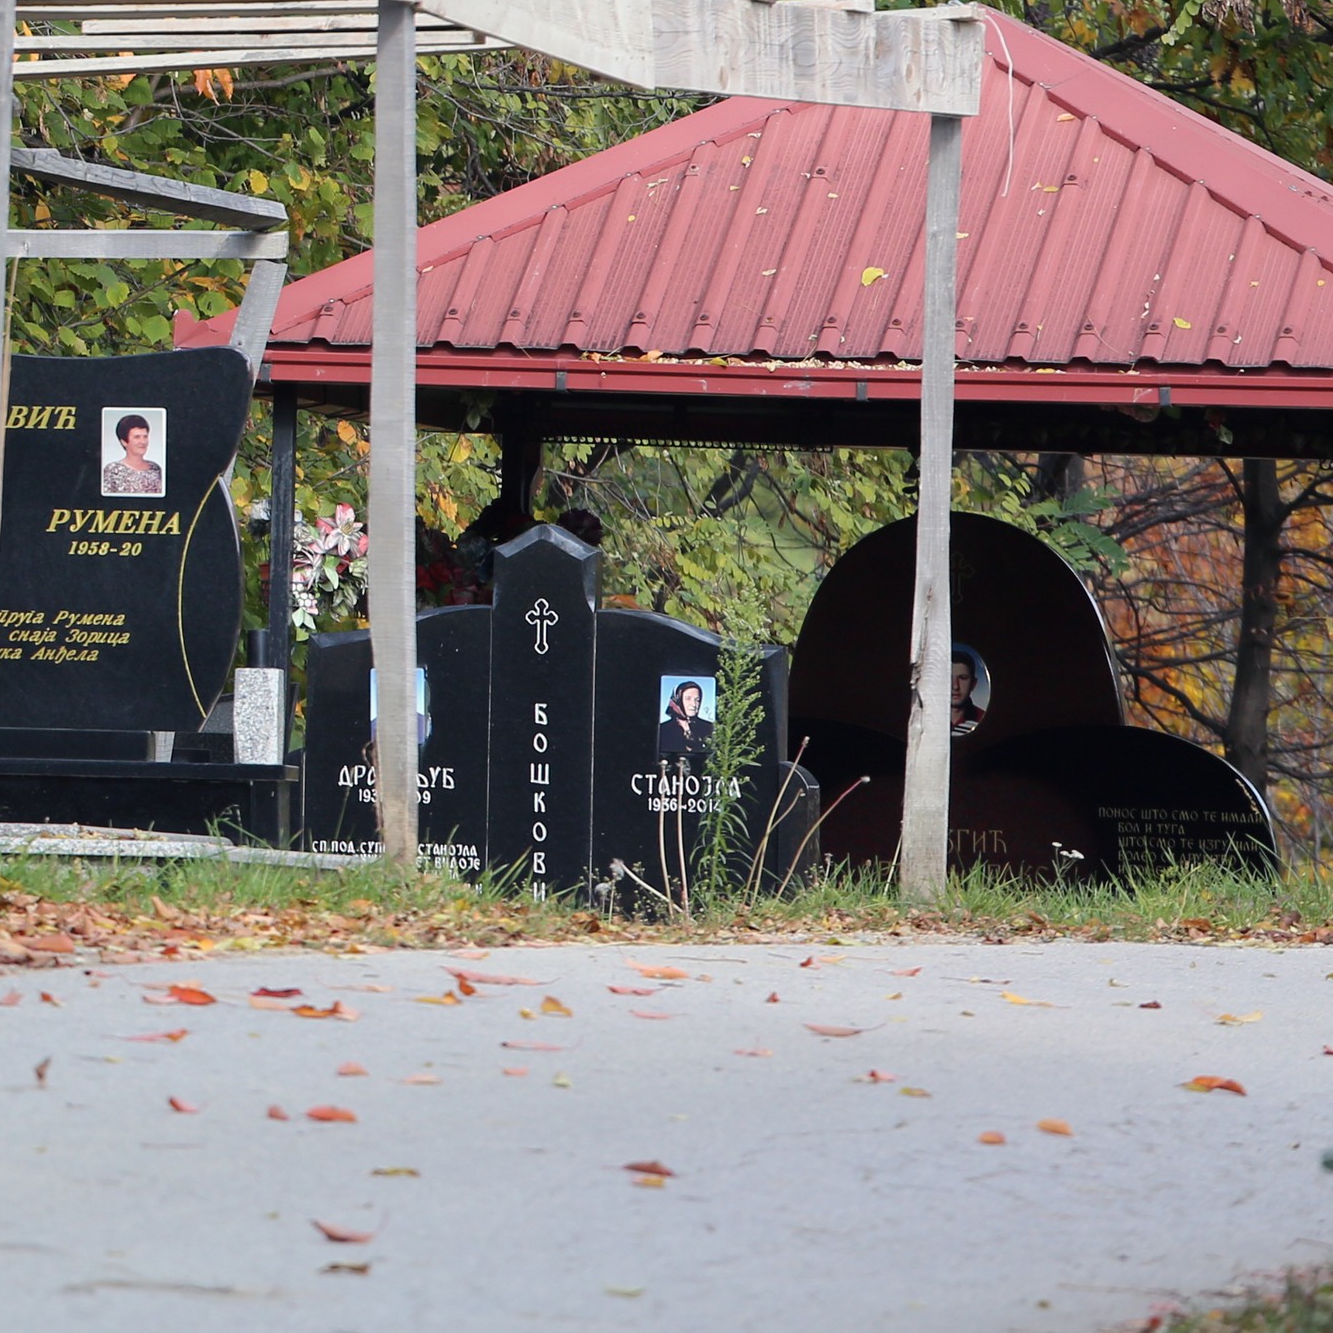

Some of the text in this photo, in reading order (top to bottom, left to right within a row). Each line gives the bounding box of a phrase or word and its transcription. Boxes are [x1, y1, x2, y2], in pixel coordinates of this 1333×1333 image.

[46, 509, 182, 536] РУМЕНА
[68, 540, 143, 558] 1958-20
[53, 610, 126, 628] Румена
[8, 627, 58, 646] снаја
[65, 629, 131, 648] Зорица
[30, 646, 100, 664] Анђела
